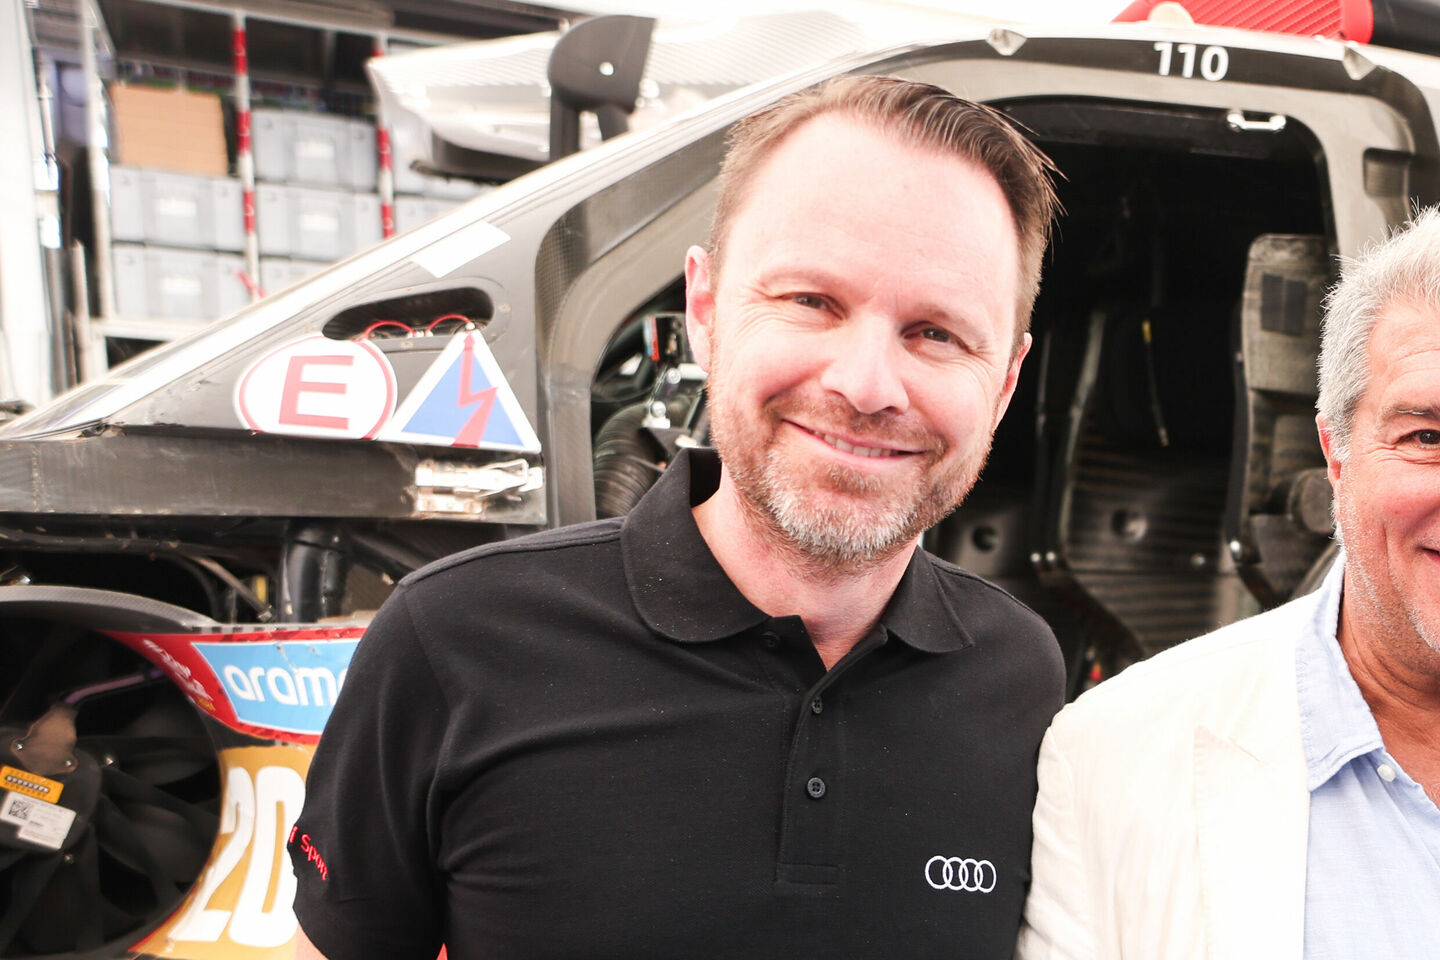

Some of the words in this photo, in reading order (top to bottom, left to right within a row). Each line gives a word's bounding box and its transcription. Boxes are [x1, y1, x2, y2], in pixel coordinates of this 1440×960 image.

[1153, 41, 1230, 82] 110
[278, 355, 355, 430] E
[301, 833, 329, 882] Sport
